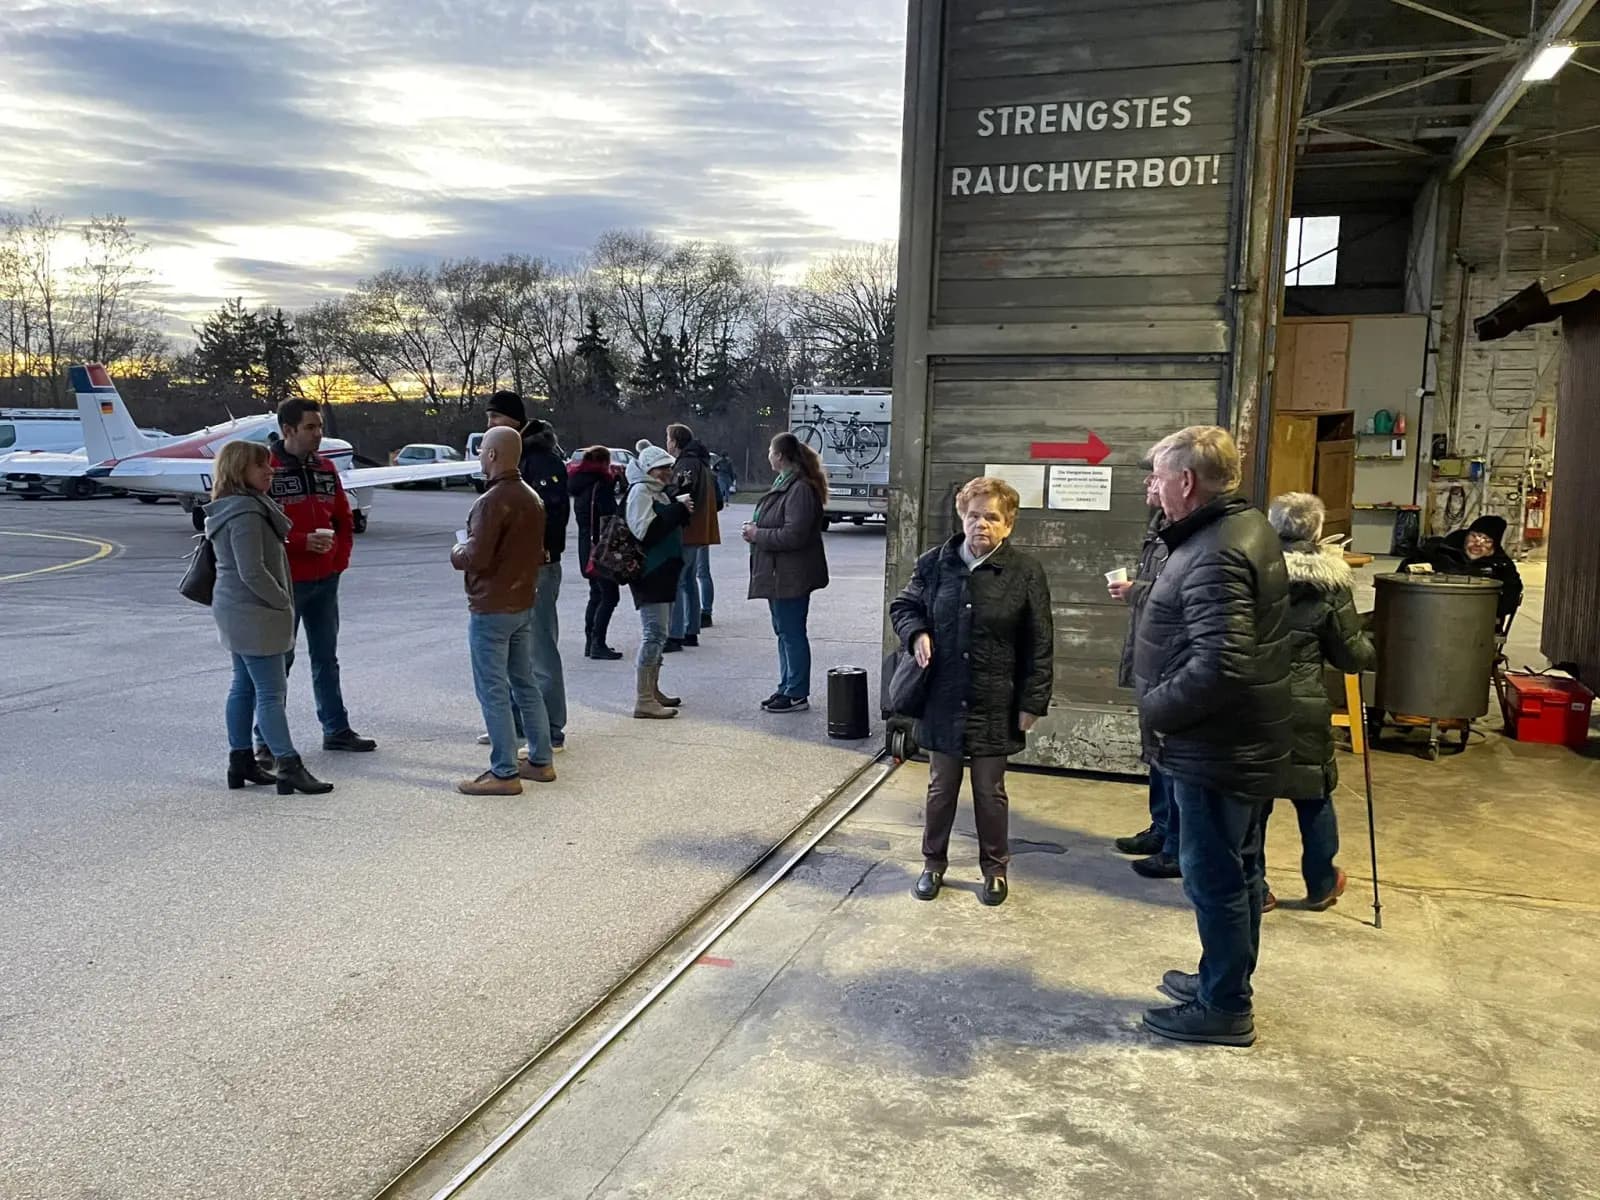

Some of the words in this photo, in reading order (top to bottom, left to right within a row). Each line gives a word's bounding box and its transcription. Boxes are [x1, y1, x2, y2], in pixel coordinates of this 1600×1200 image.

[977, 95, 1192, 137] STRENGSTES
[951, 154, 1220, 196] RAUCHVERBOT!
[271, 476, 303, 496] 63
